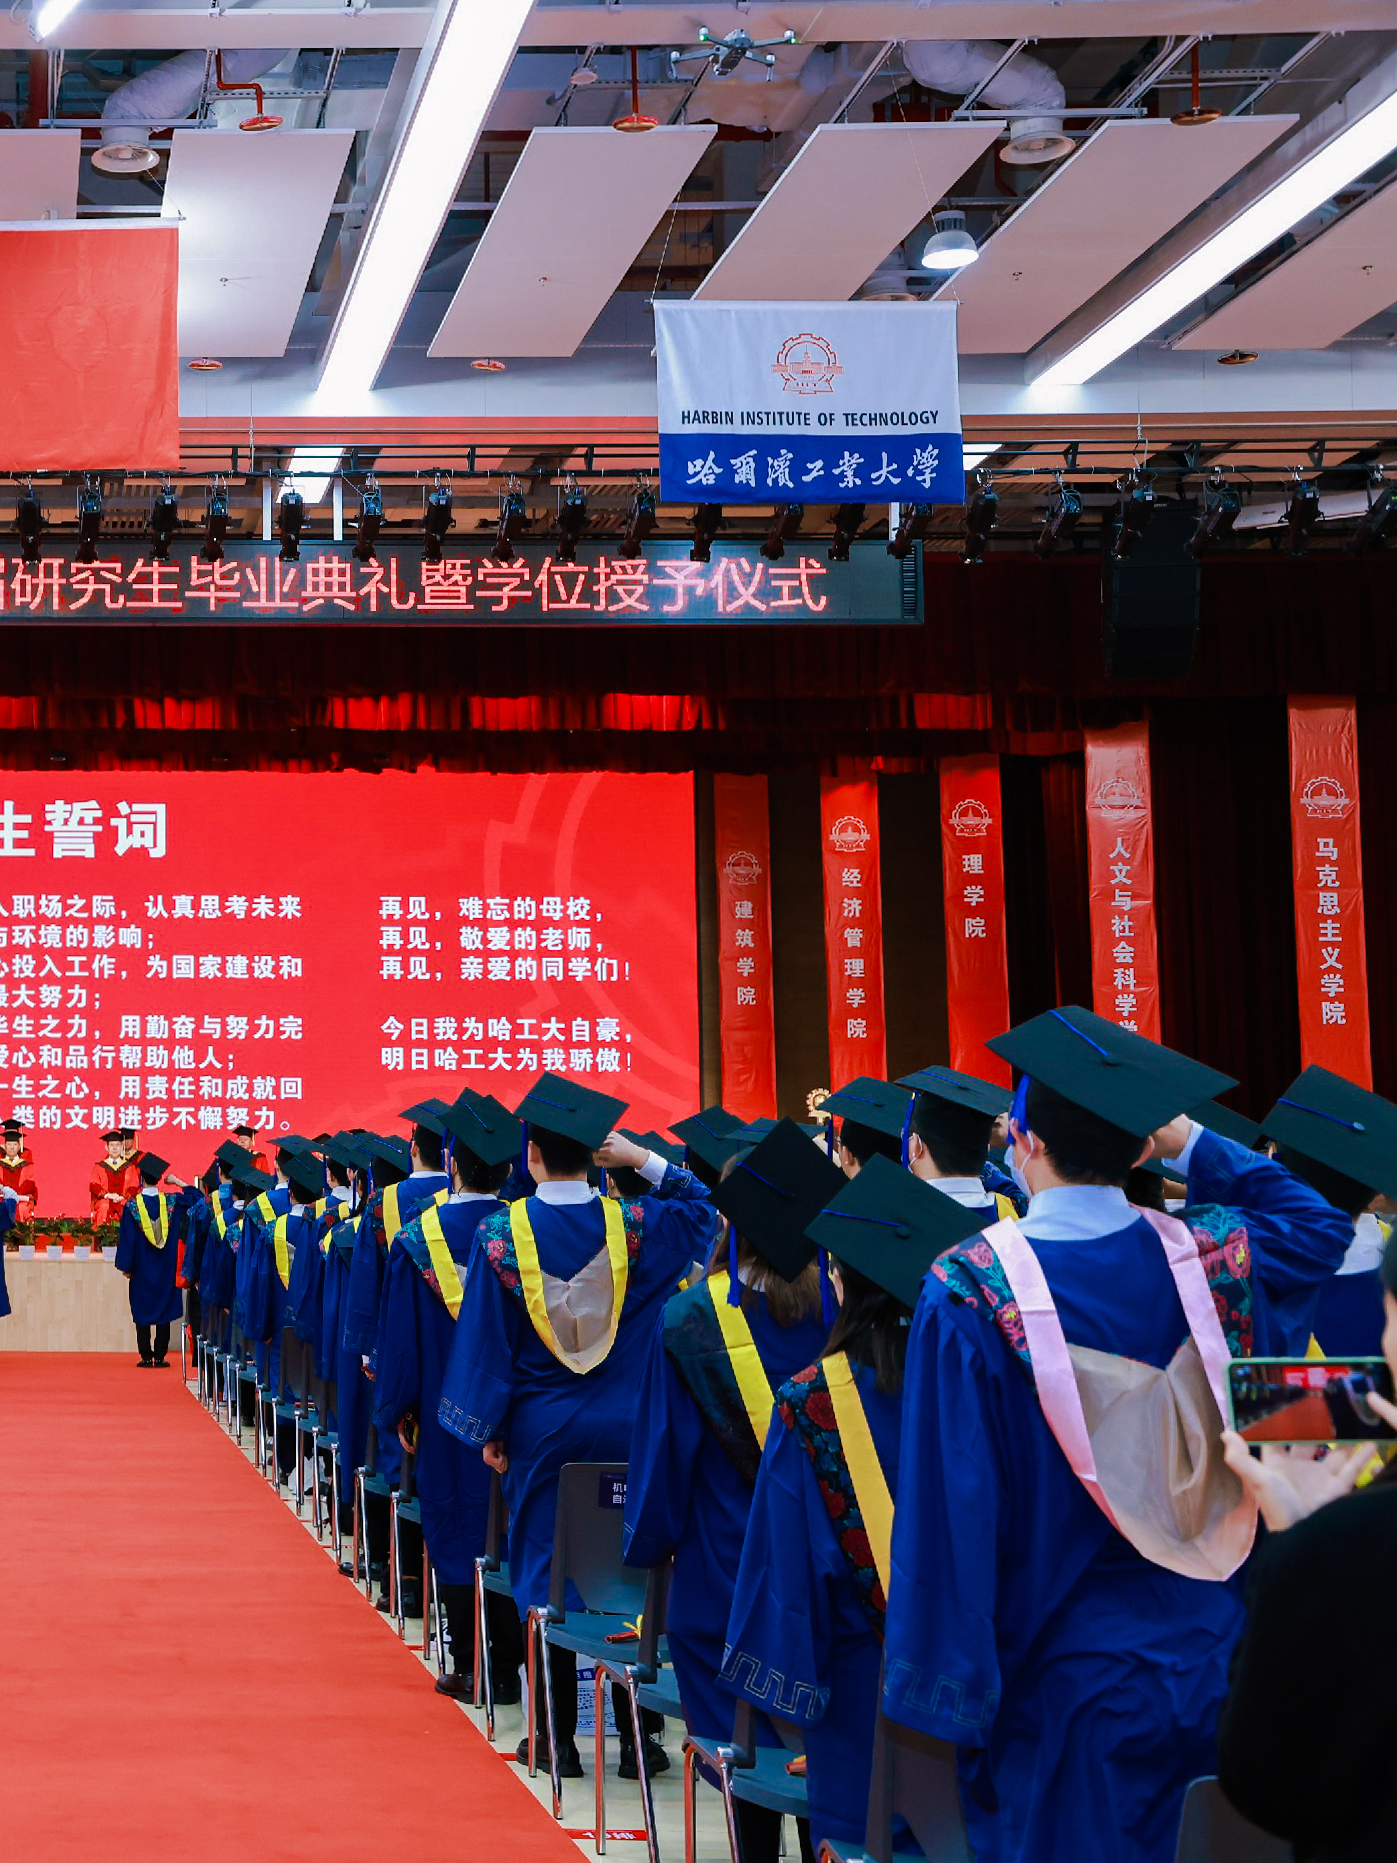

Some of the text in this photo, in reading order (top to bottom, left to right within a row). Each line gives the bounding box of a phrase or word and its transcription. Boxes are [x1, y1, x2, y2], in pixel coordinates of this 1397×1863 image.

[681, 410, 939, 427] HARBIN INSTITUTE OF TECHNOLOGY
[378, 896, 603, 923] 再见，难忘的母校，
[962, 854, 986, 938] 理学院
[378, 925, 604, 953] 再见，敬爱的老师，
[1315, 837, 1347, 1025] 马克思主义学院
[734, 900, 757, 1006] 建筑学院
[841, 867, 868, 1039] 经济管理学院
[379, 955, 631, 982] 再见，亲爱的同学们！
[380, 1015, 633, 1043] 今日我为哈工大自豪，
[380, 1046, 632, 1073] 明日哈工大为我骄傲！
